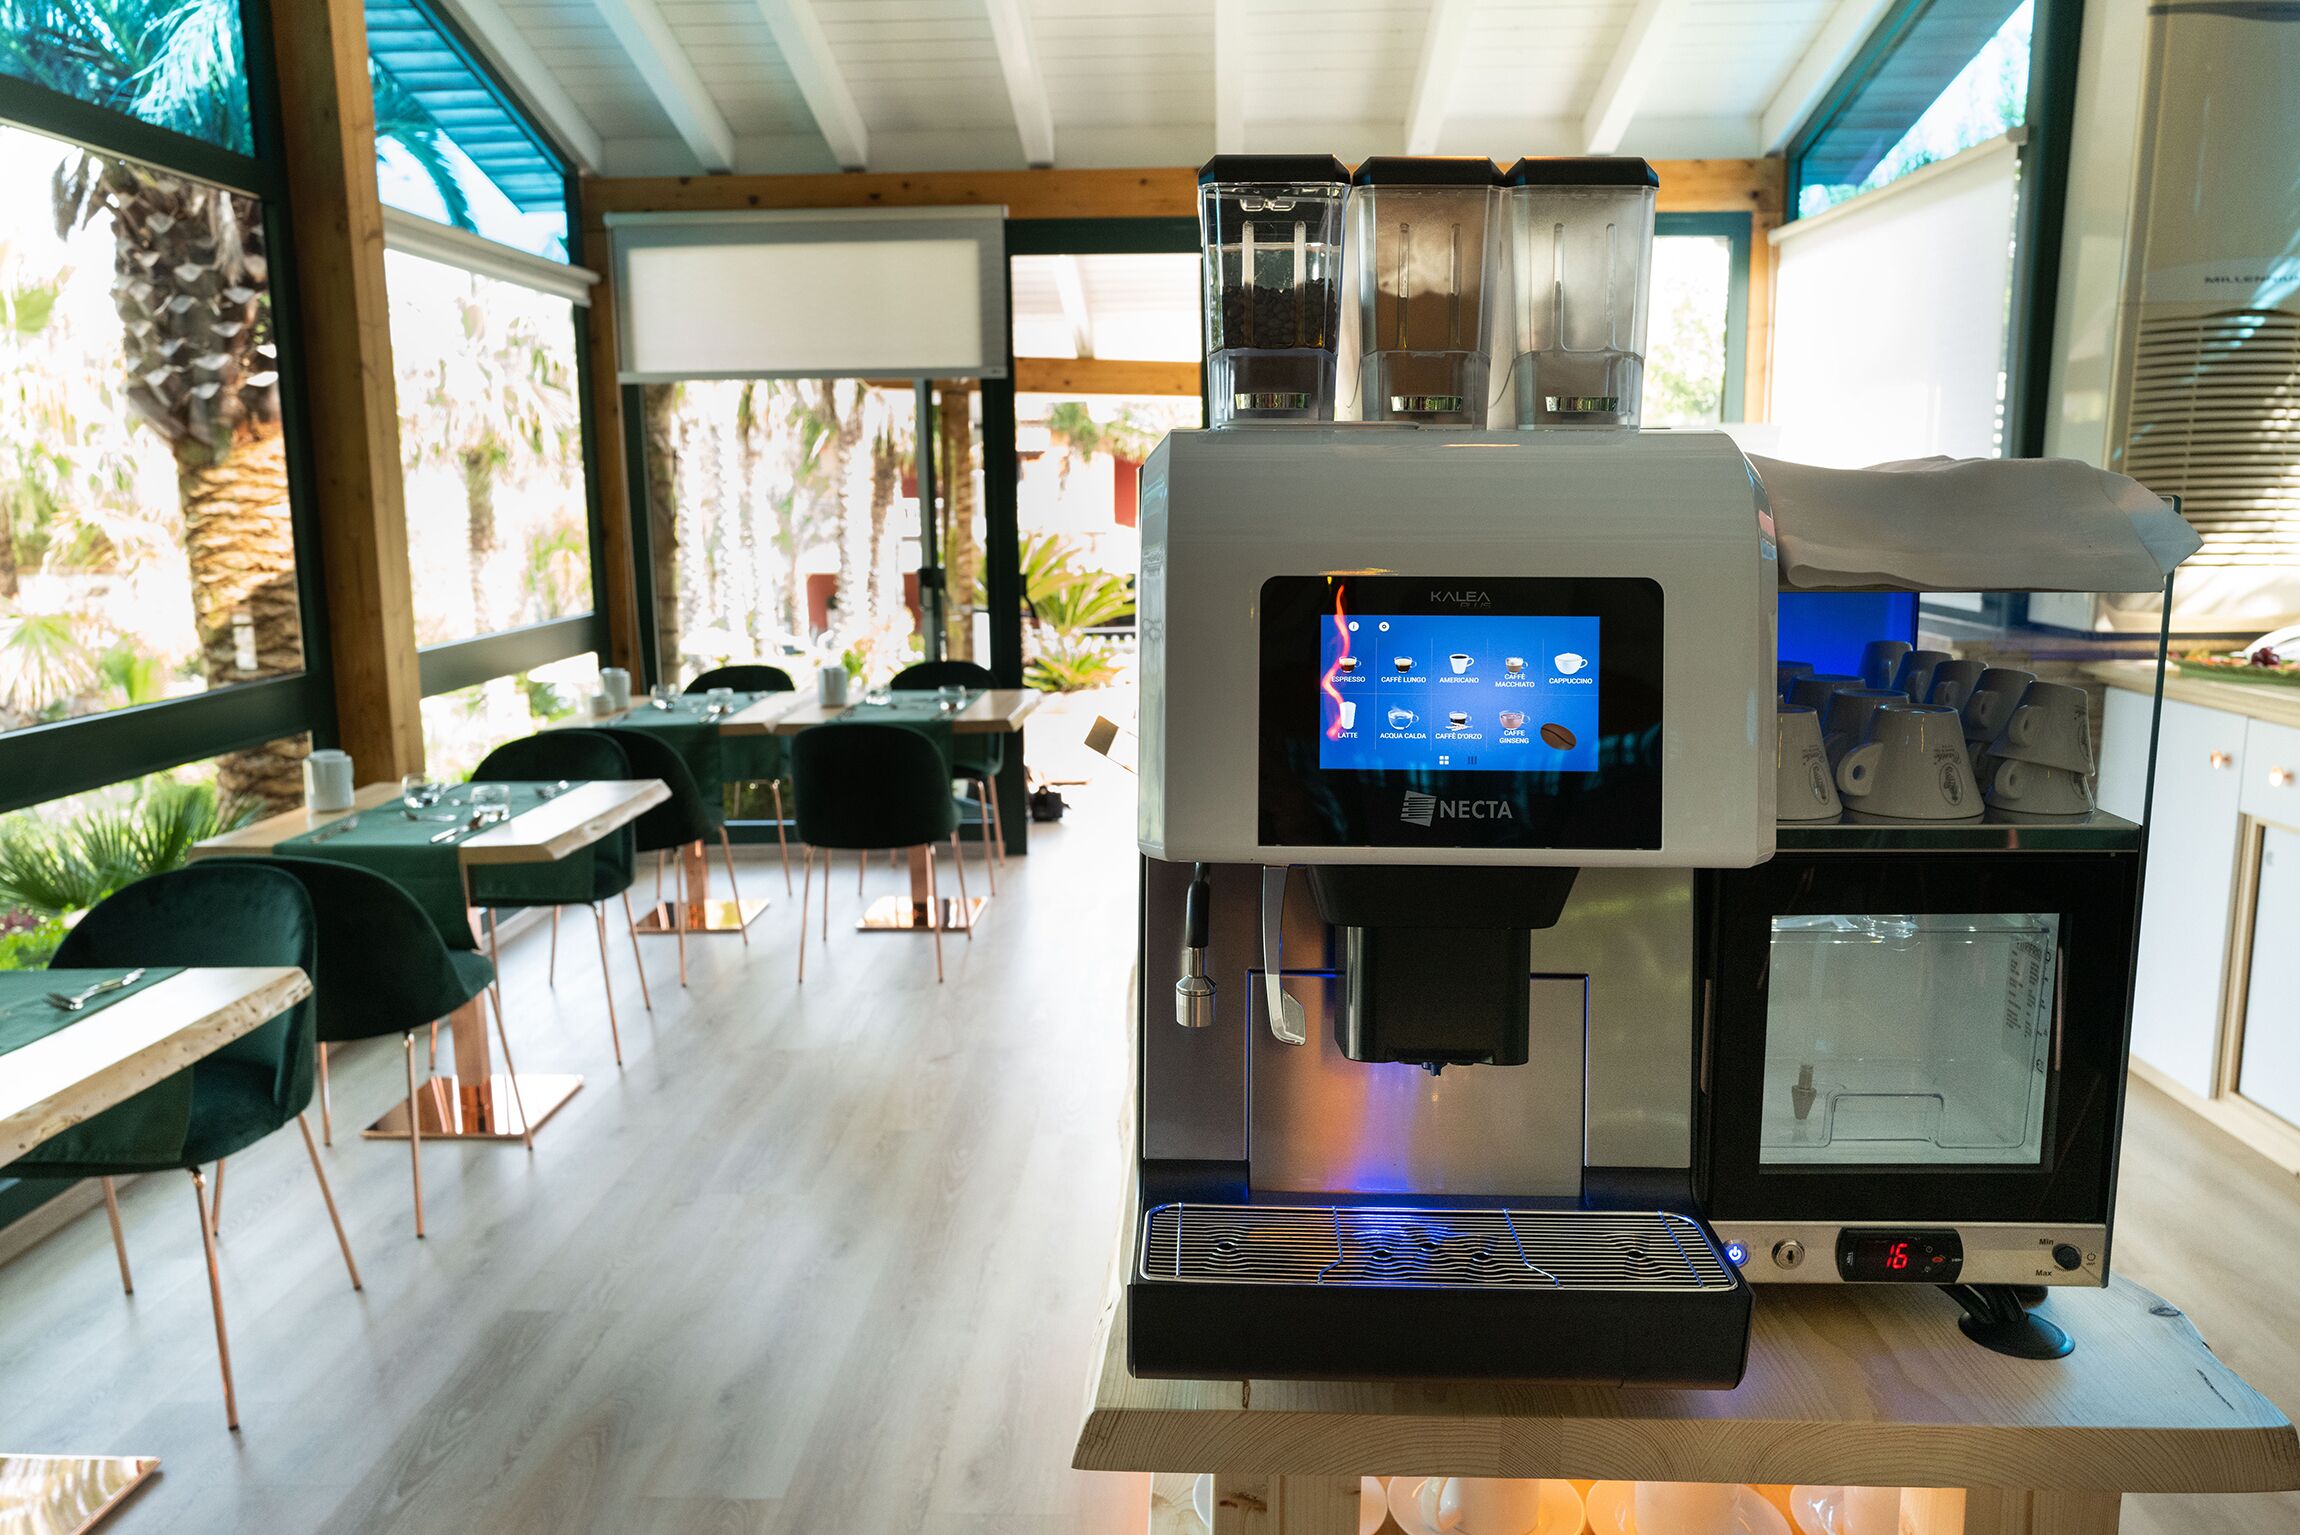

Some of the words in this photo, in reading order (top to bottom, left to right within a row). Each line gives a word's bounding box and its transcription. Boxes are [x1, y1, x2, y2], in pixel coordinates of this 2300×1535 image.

[1430, 591, 1491, 602] KALEA
[1381, 675, 1402, 683] CAFFÈ
[1435, 731, 1457, 740] CAFFÈ
[1439, 800, 1513, 819] NECTA
[2038, 1237, 2054, 1246] Min
[1885, 1242, 1909, 1270] 16
[2035, 1269, 2053, 1277] Max
